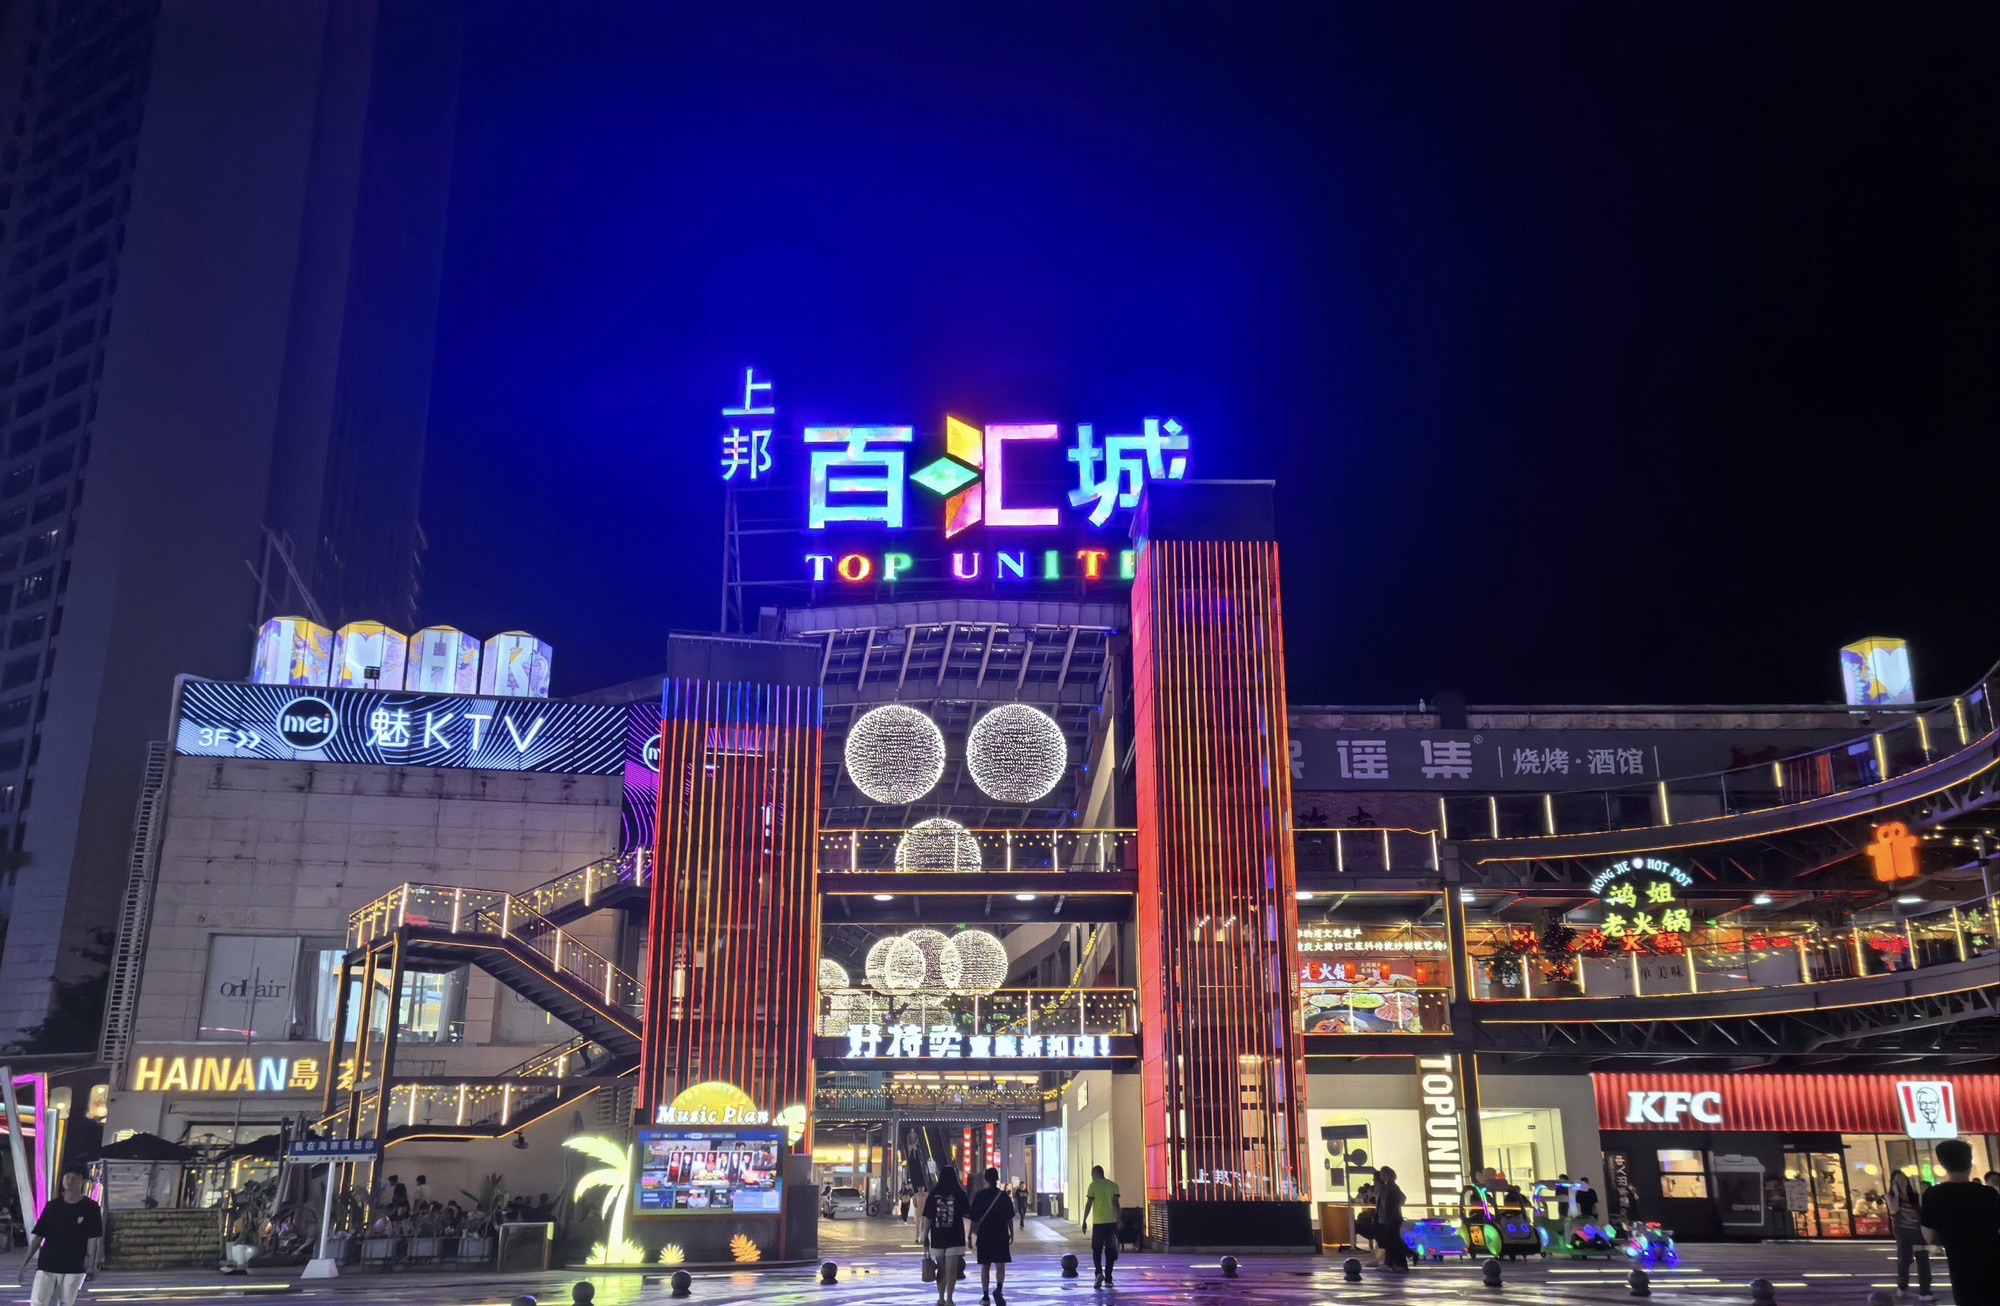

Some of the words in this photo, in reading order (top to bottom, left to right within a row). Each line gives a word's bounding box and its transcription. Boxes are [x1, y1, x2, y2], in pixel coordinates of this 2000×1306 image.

[721, 367, 775, 481] 上邦
[803, 412, 1190, 540] 百汇城
[804, 552, 912, 583] TOP
[199, 729, 230, 747] 3F
[284, 713, 330, 734] mei
[1590, 868, 1616, 894] HONG
[1613, 860, 1631, 875] JIE
[1646, 858, 1670, 874] HOT
[1669, 867, 1693, 887] POT
[1609, 881, 1676, 909] 鸿姐
[1600, 908, 1692, 937] 老火锅
[656, 1104, 718, 1124] Music
[1626, 1091, 1723, 1124] KFC
[1420, 1055, 1464, 1227] TOPUNITE
